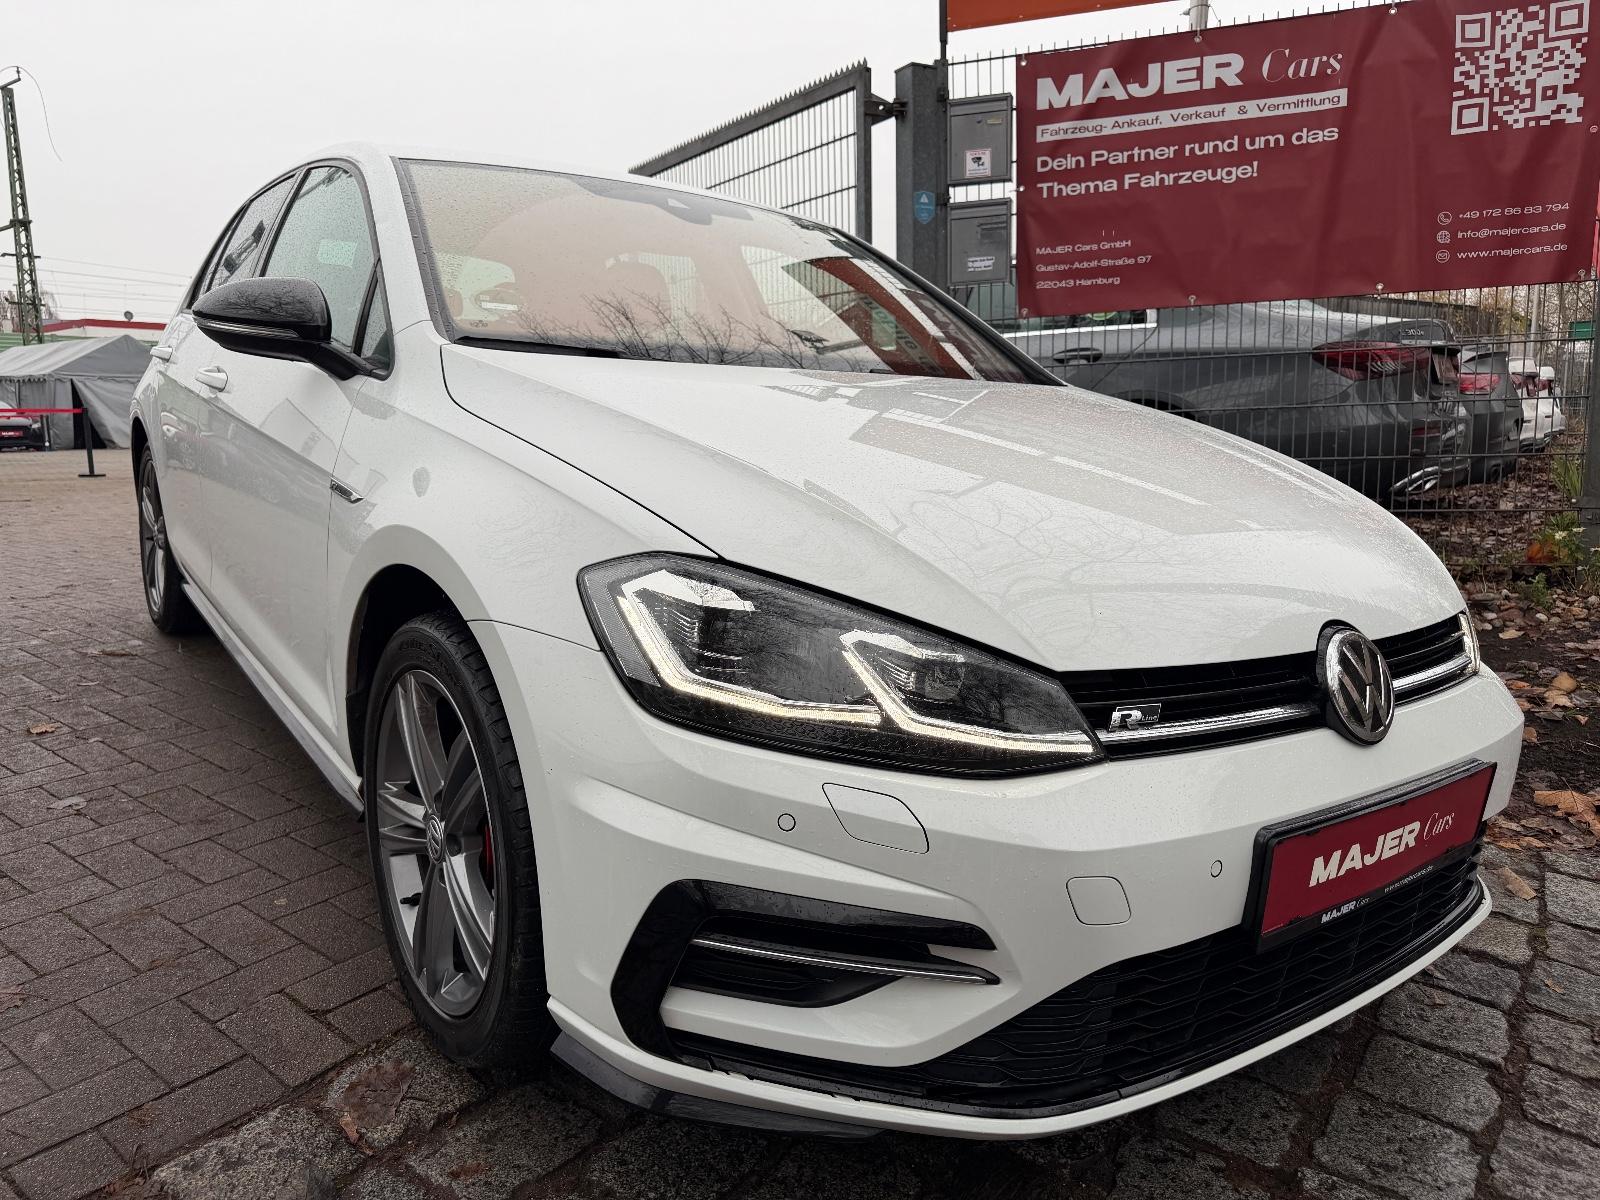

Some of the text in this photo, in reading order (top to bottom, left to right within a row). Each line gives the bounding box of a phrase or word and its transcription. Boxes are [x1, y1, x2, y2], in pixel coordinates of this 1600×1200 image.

[1036, 48, 1343, 111] MAJER Cars
[1111, 115, 1163, 131] Ankauf,
[1170, 107, 1227, 123] Verkauf
[1237, 105, 1249, 115] &
[1256, 94, 1341, 114] Vermittlung
[1036, 127, 1340, 173] Dein Partner rund um das
[1037, 160, 1259, 199] Thema Fahrzeuge!
[1458, 202, 1570, 219] +49 172 86 83 794
[1036, 239, 1132, 256] MAJER Cars GmbH
[1457, 242, 1568, 259] www.majercars.de
[1036, 255, 1152, 273] Gustav-Adolf-Straße 97
[1036, 276, 1121, 290] 22043 Hamburg
[1308, 811, 1455, 888] MAJER Cars
[1321, 900, 1356, 924] MAJER
